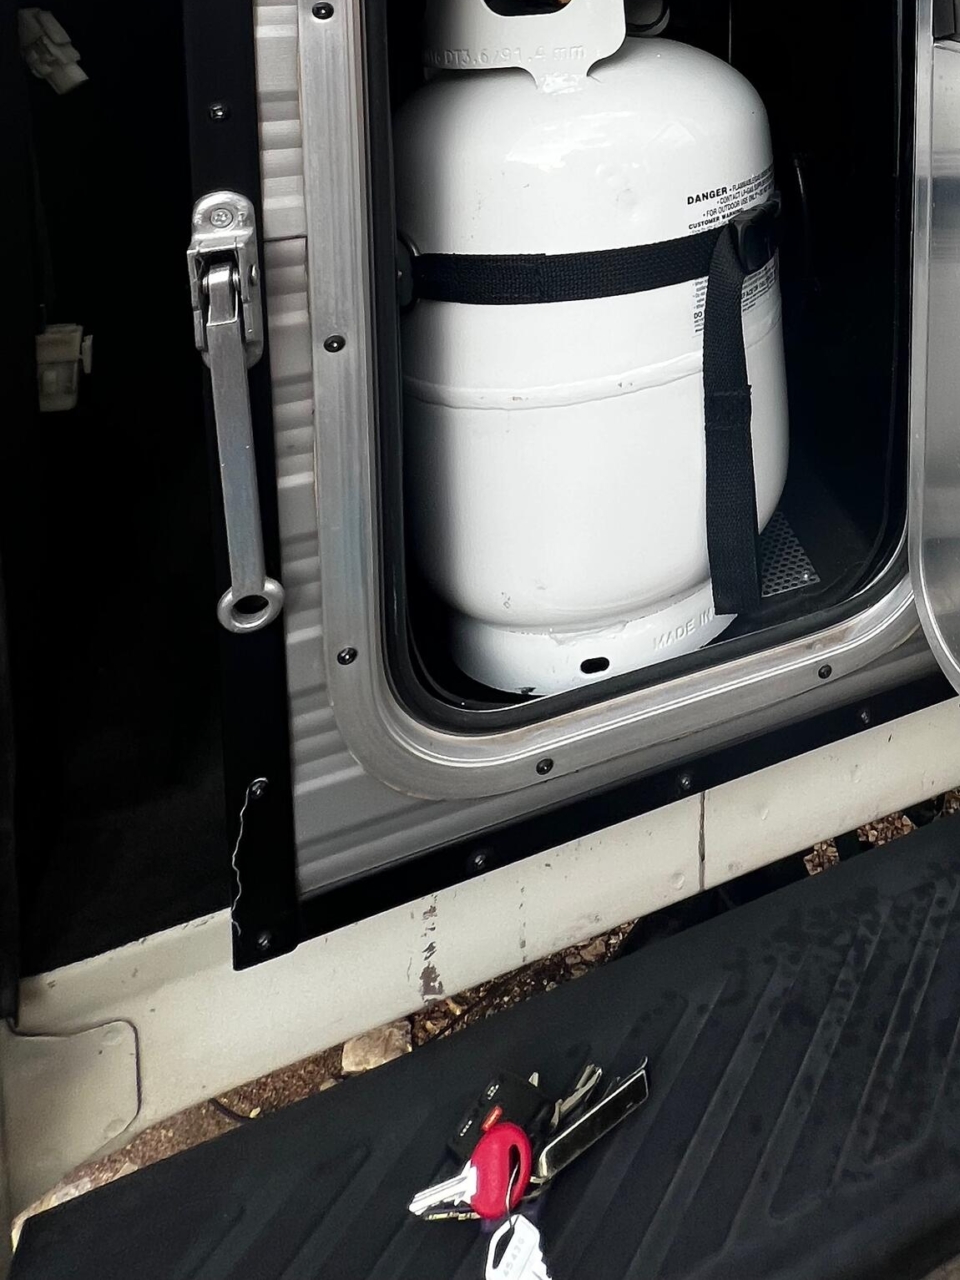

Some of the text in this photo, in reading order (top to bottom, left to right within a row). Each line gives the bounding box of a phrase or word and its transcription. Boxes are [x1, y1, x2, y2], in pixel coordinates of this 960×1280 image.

[687, 186, 728, 205] DANGER
[706, 208, 718, 218] FOR
[718, 200, 740, 214] OUTDOOR
[688, 215, 720, 230] CUSTOMER
[653, 618, 696, 651] MADE
